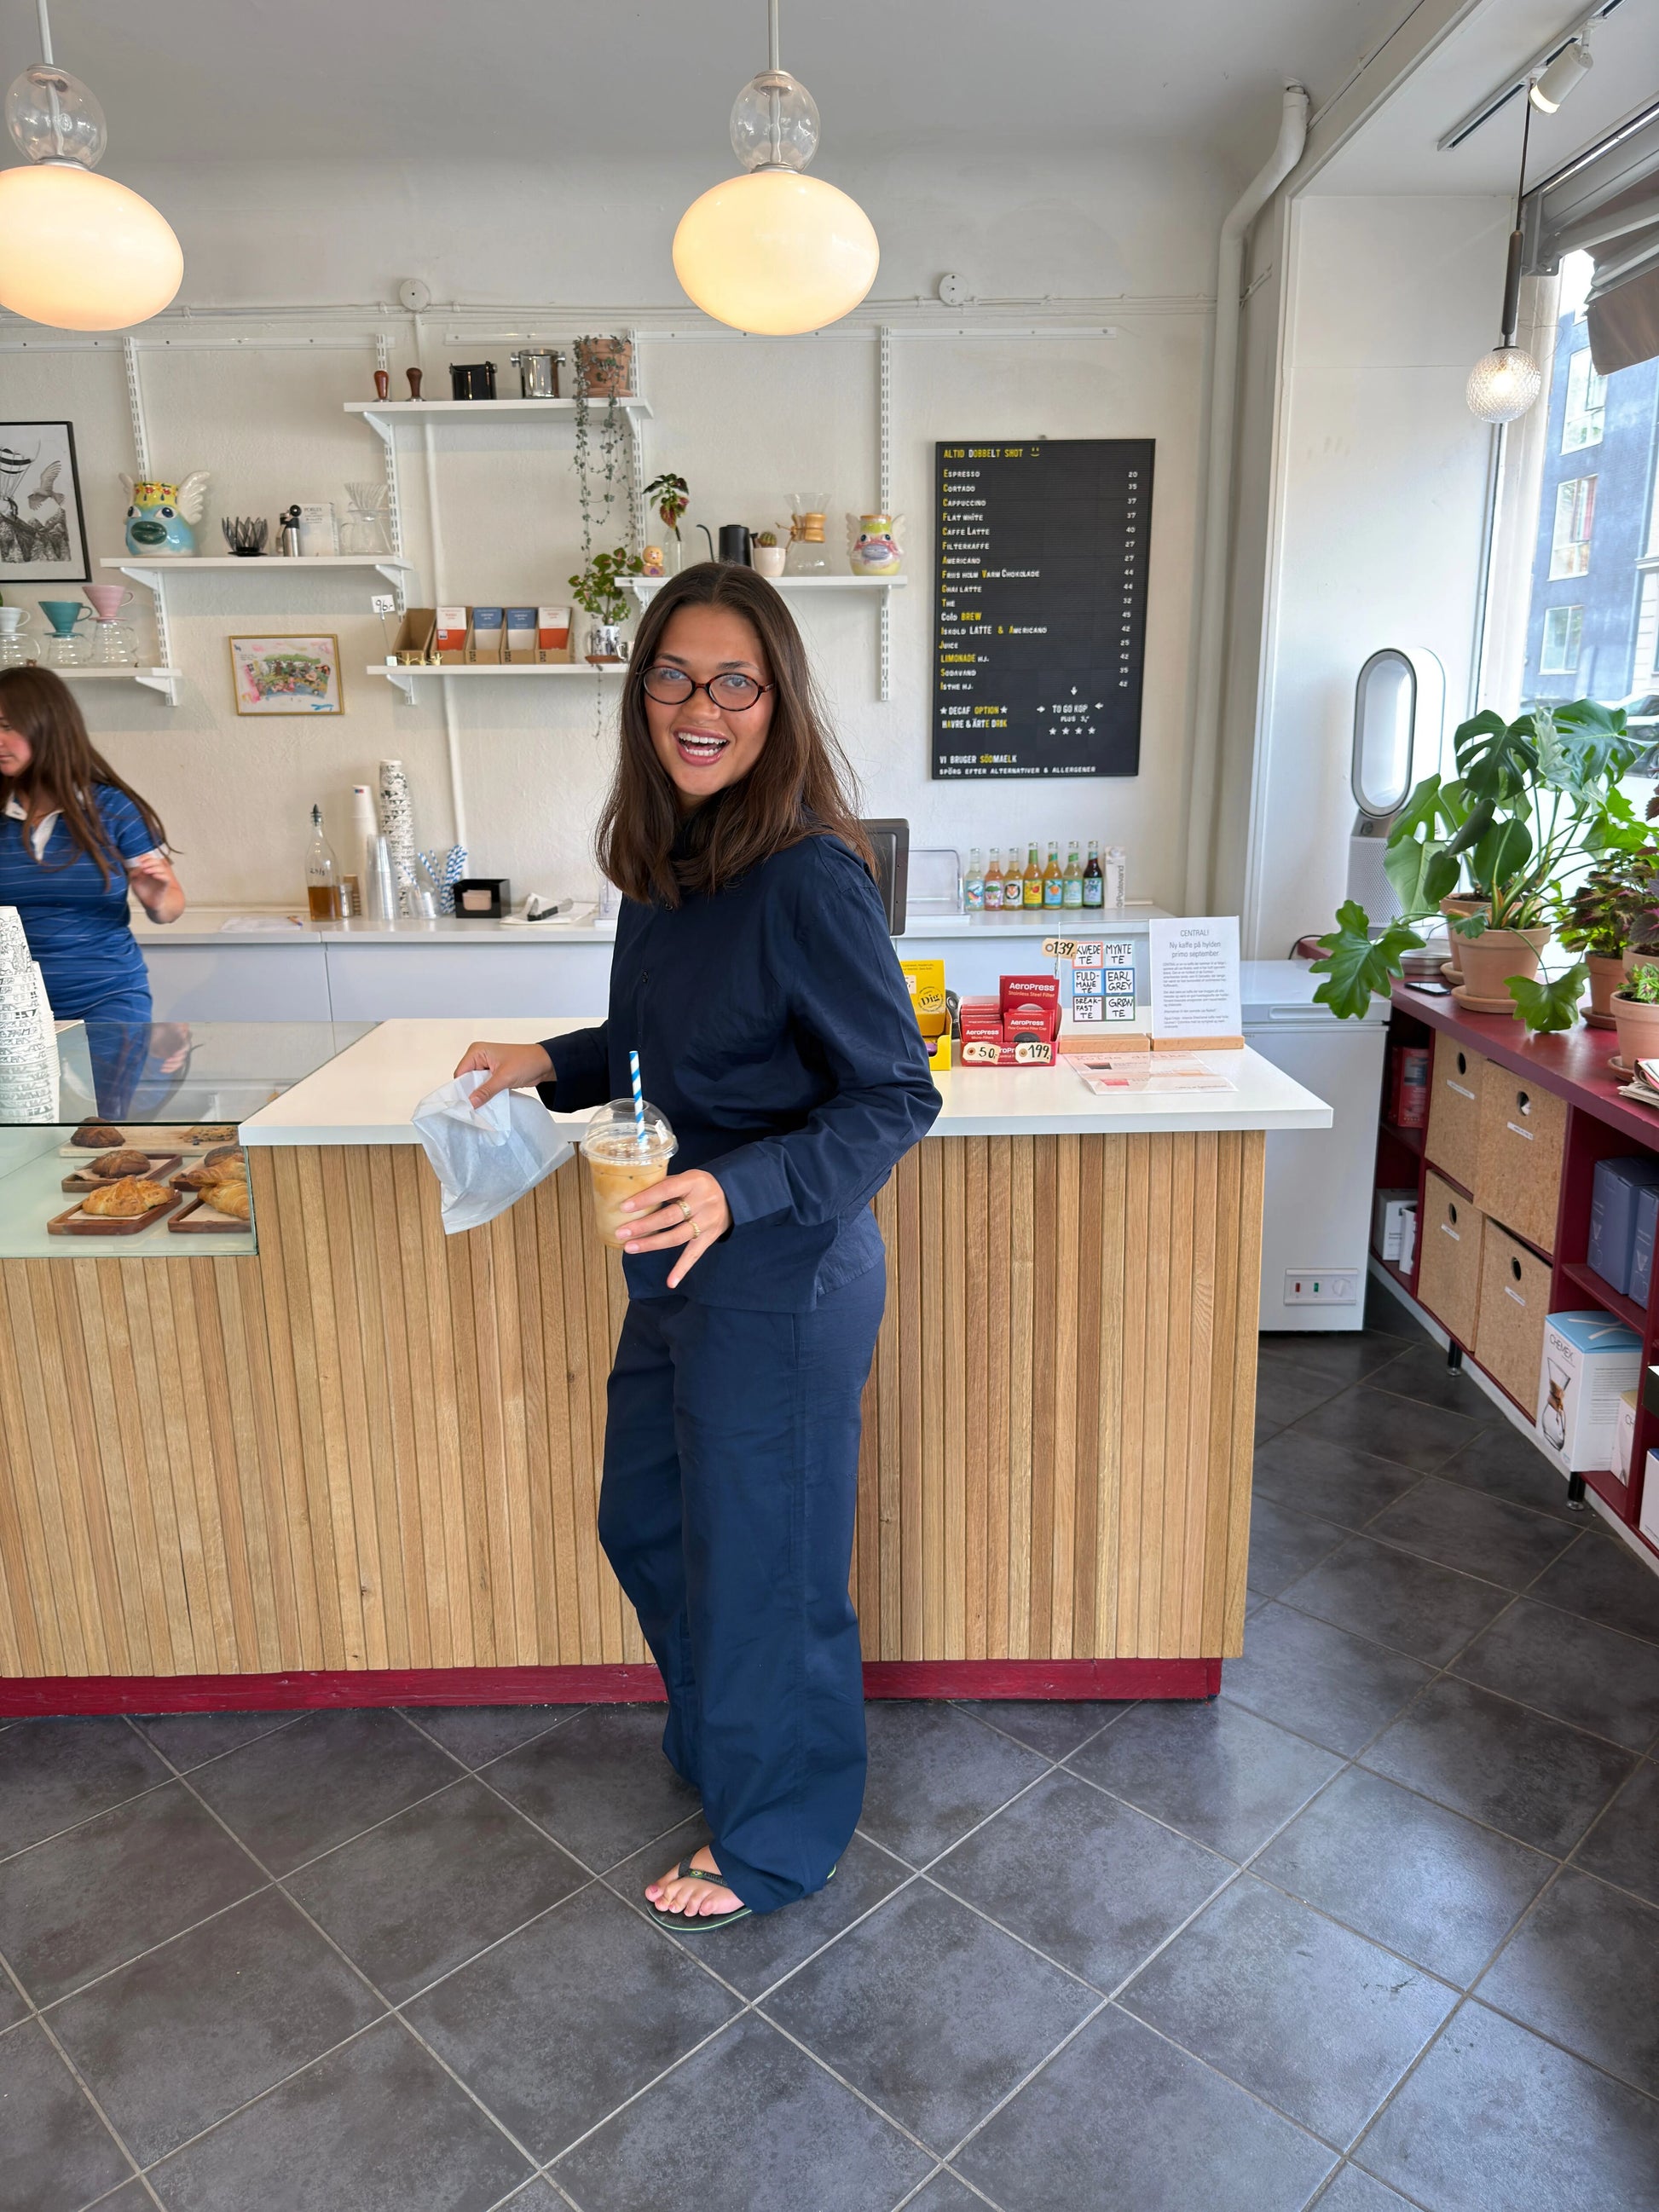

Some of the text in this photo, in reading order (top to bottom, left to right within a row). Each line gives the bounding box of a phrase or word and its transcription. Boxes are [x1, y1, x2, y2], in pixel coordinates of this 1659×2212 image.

[968, 448, 1001, 458] DOBBELT
[1004, 448, 1023, 458] SHOT
[961, 613, 982, 621] BREW
[969, 626, 992, 635] LATTE
[997, 626, 1003, 634] &
[948, 706, 971, 715] DECAF
[1052, 704, 1062, 713] TO
[1062, 704, 1073, 713] GO
[939, 755, 947, 765] VI
[1194, 940, 1201, 949] på
[1202, 939, 1221, 948] hylden
[1106, 944, 1132, 955] MYNTE
[1078, 956, 1093, 965] TE
[1111, 956, 1124, 964] TE
[1107, 972, 1130, 981] EARL
[1009, 982, 1055, 991] AeroPress
[1108, 982, 1132, 991] GREY
